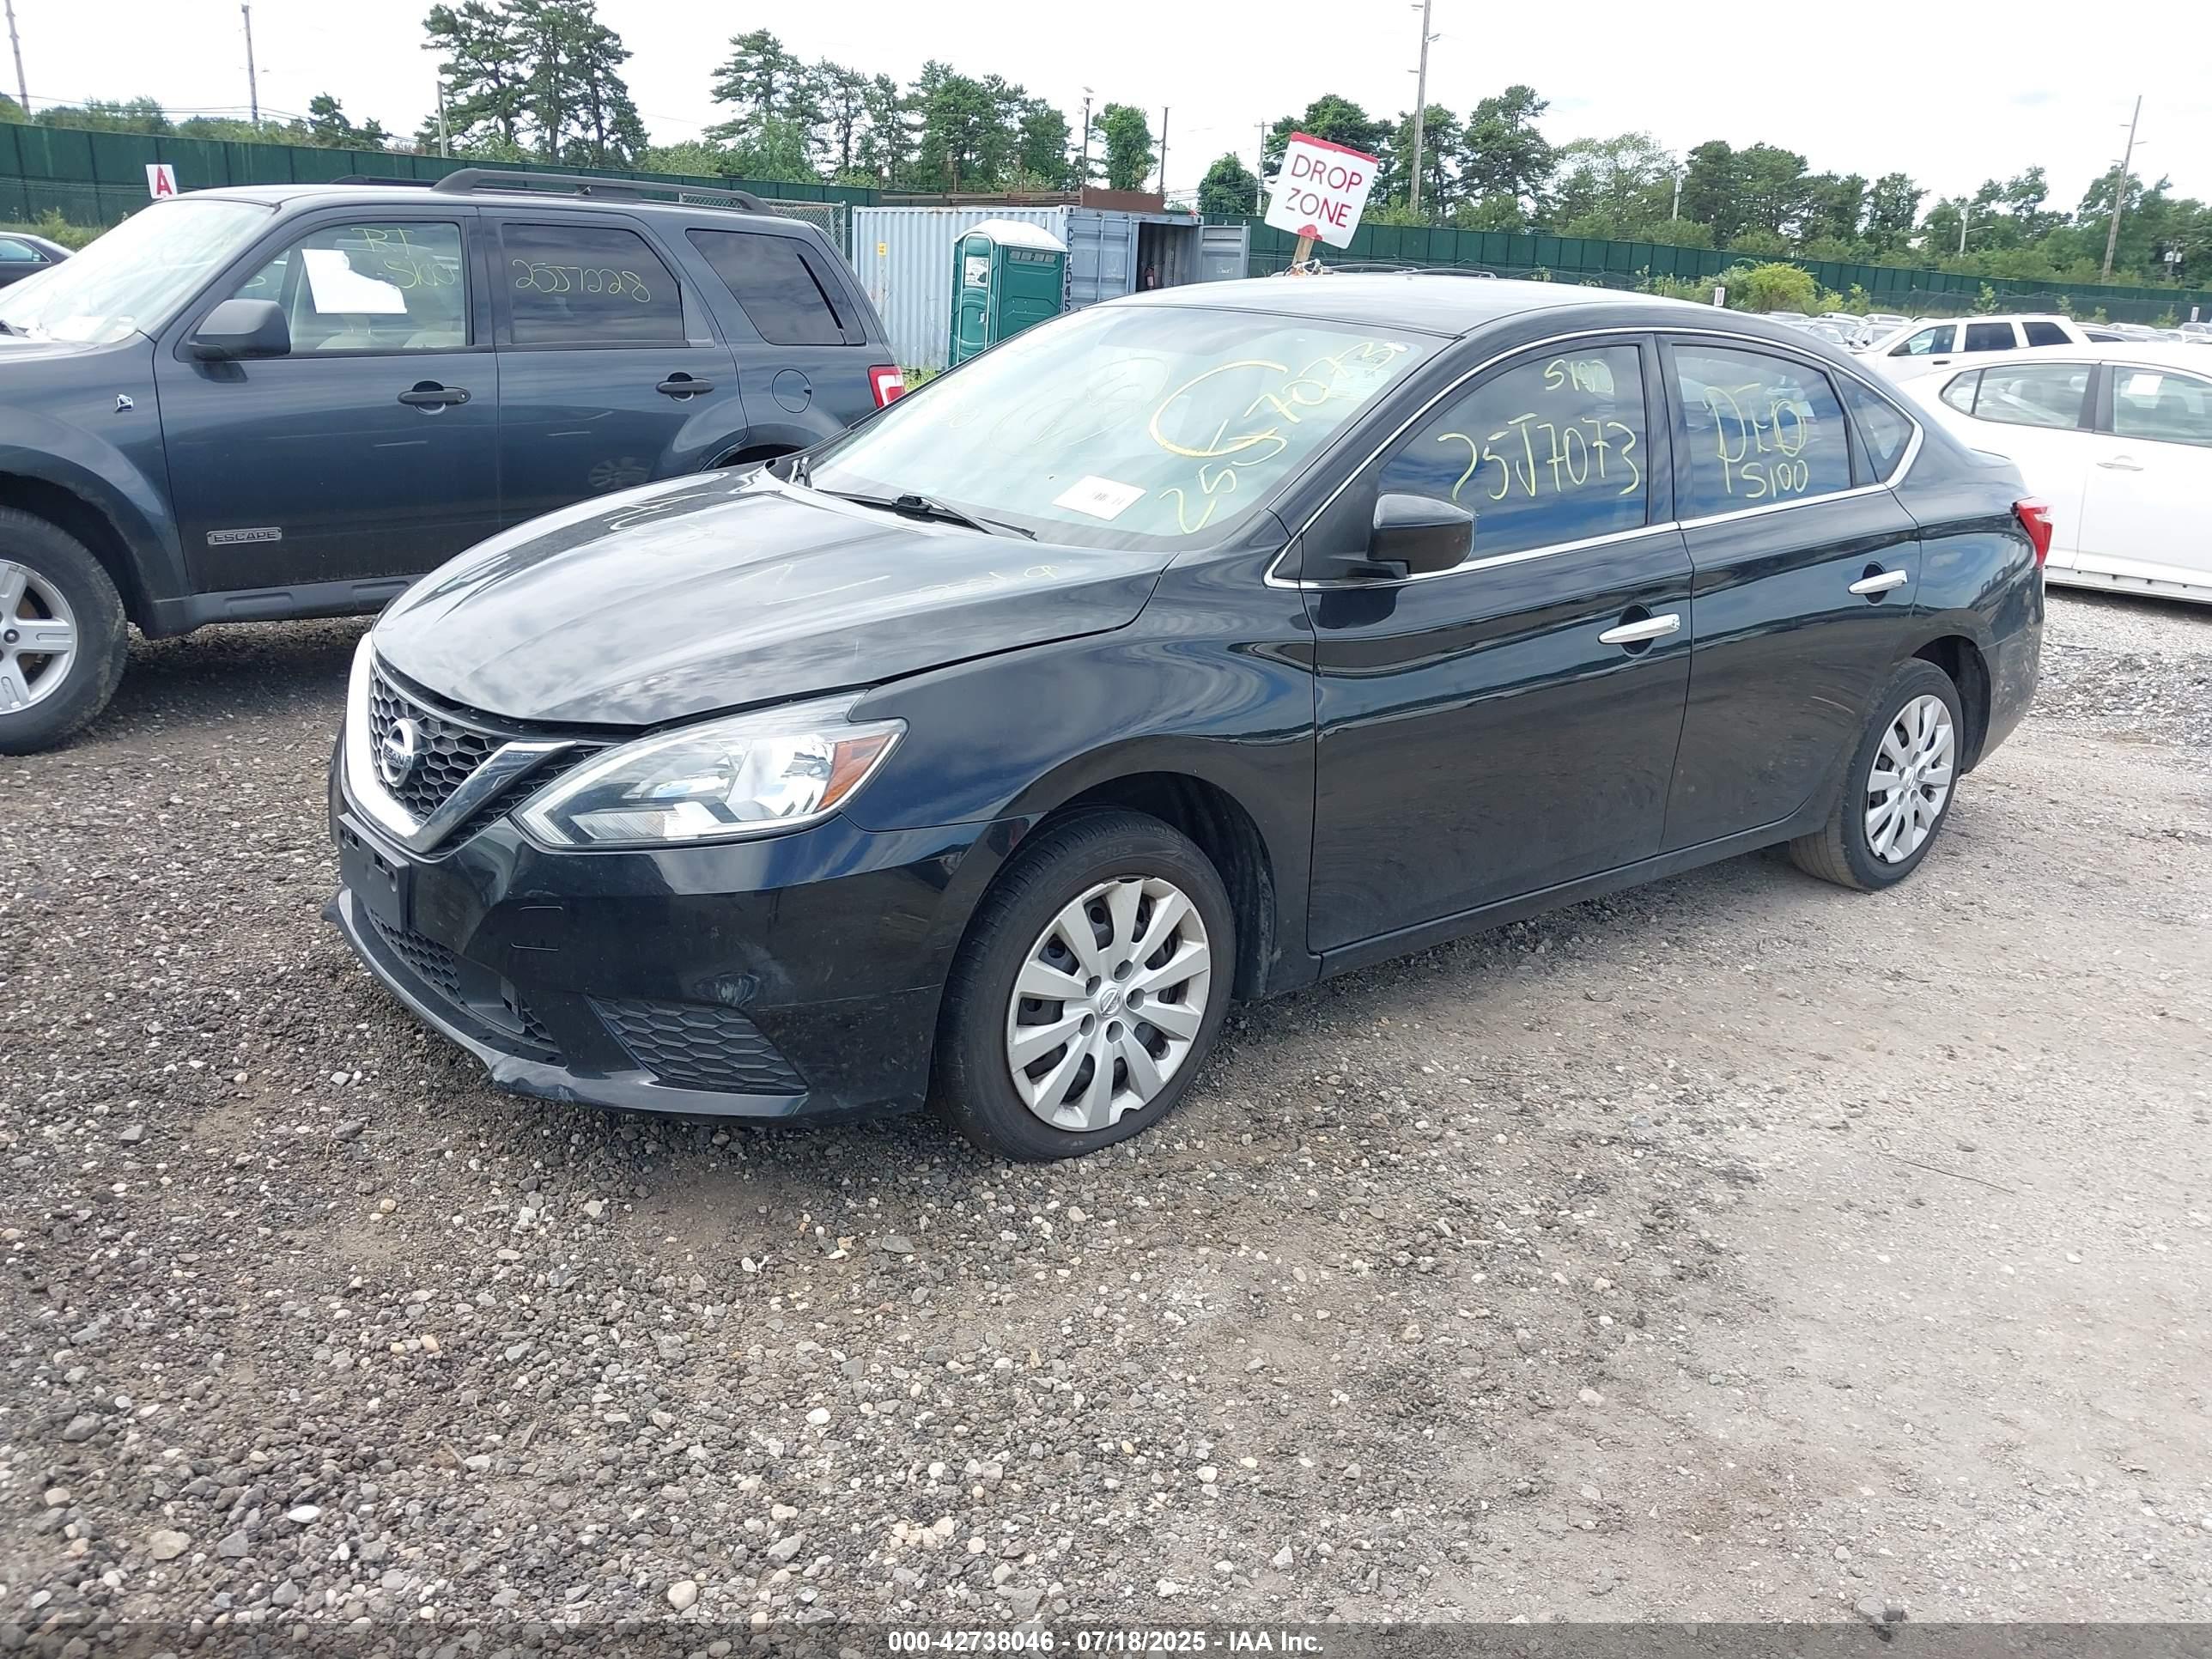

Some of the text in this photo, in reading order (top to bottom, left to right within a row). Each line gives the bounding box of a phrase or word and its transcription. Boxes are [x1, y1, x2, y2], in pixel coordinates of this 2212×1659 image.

[156, 166, 173, 195] A
[1291, 154, 1362, 193] DROP
[1285, 187, 1352, 228] ZONE
[213, 531, 276, 543] ESCAPE
